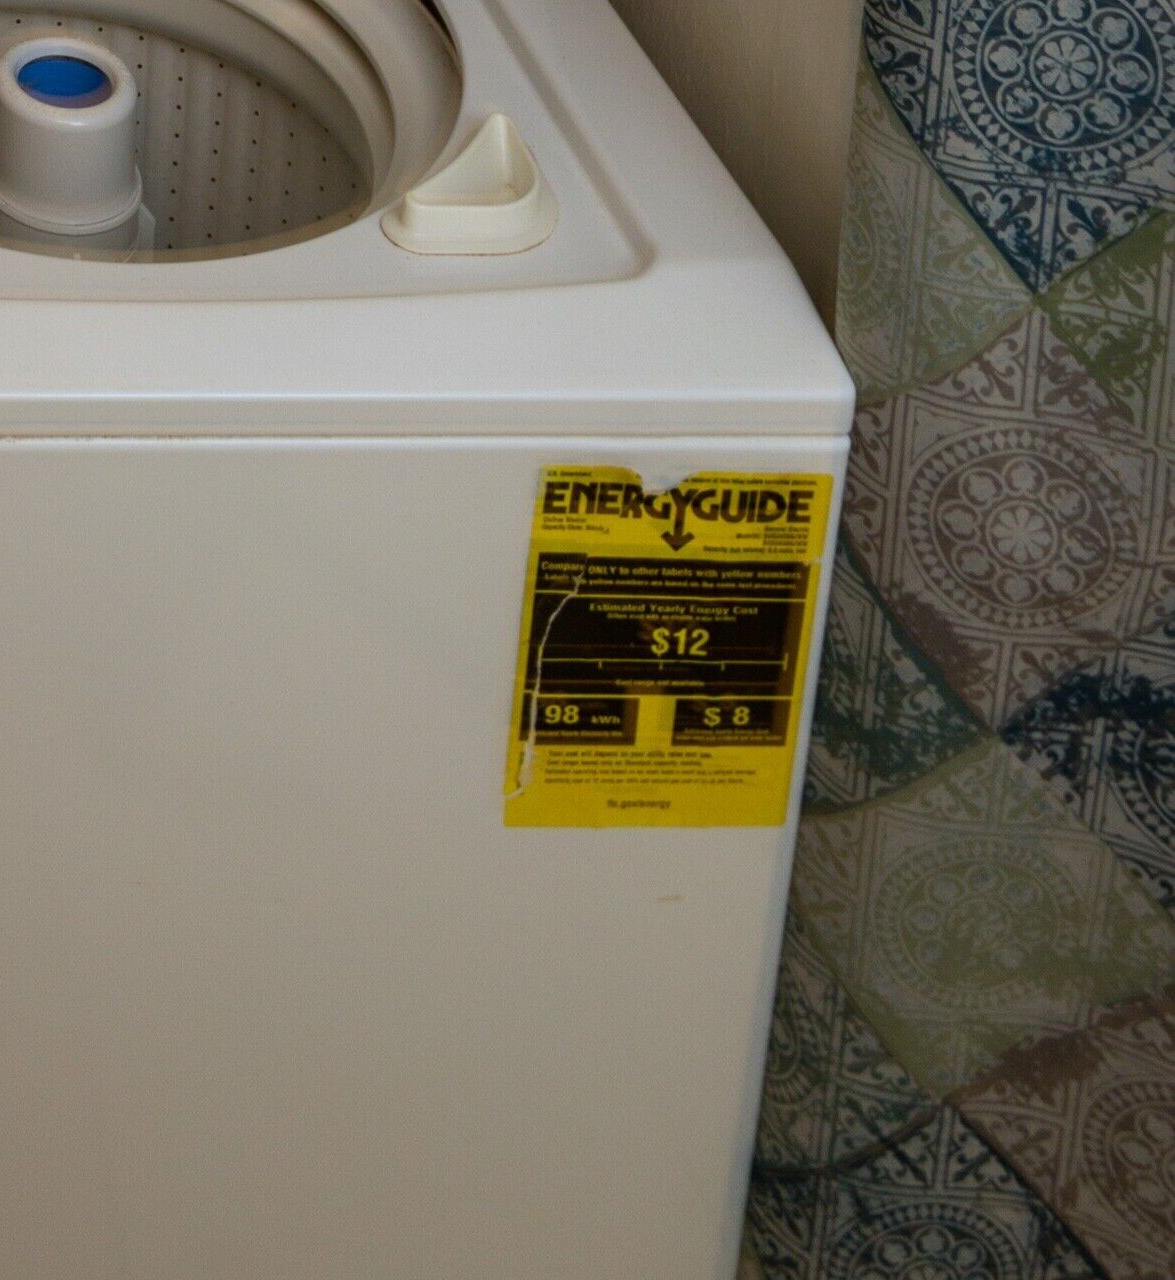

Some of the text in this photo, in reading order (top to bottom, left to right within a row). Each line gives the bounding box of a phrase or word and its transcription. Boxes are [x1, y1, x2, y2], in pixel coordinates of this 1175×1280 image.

[543, 482, 815, 524] ENERGYGUIDE
[541, 561, 802, 579] Compare ONLY to other labels with yellow numbers
[590, 603, 758, 615] Estimated Yearly Energy Cost
[651, 627, 710, 656] $12
[545, 705, 620, 724] 98 kWh
[704, 707, 750, 726] $ 8
